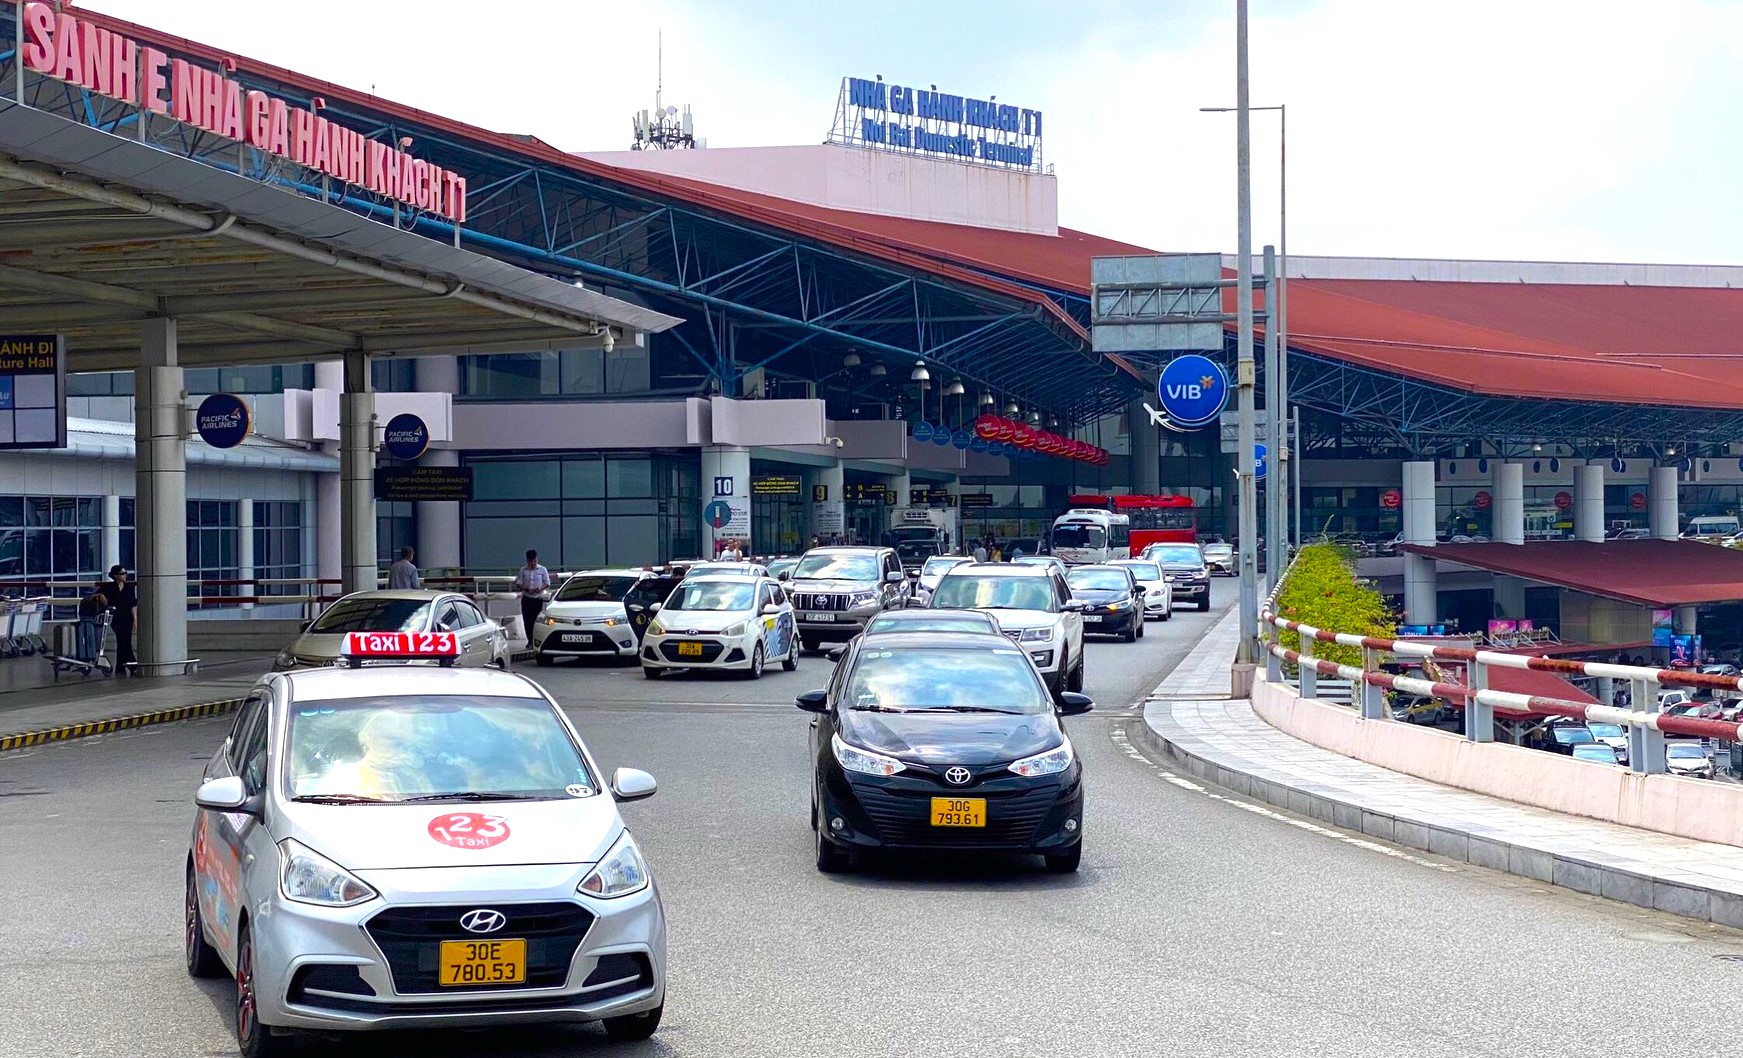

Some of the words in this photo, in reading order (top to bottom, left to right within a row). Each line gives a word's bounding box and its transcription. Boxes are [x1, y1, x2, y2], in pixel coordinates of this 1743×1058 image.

[890, 85, 914, 115] GA
[1022, 109, 1042, 136] T1
[143, 47, 167, 113] E
[245, 90, 289, 158] GA
[443, 170, 466, 223] T1
[914, 126, 976, 158] Domestic
[977, 137, 1033, 166] Terminal
[39, 342, 54, 354] ĐI
[28, 356, 54, 368] Hall
[1167, 384, 1202, 399] VIB
[201, 415, 230, 423] PACIFIC
[202, 420, 238, 430] AIRLINES
[715, 479, 732, 494] 10
[816, 485, 825, 501] 9
[354, 633, 400, 652] Taxi
[405, 633, 451, 652] 123
[947, 800, 970, 812] 30G
[938, 813, 978, 825] 793.61
[434, 815, 508, 841] 123
[456, 836, 490, 847] Taxi
[466, 943, 501, 961] 30E
[451, 963, 516, 982] 780.53
